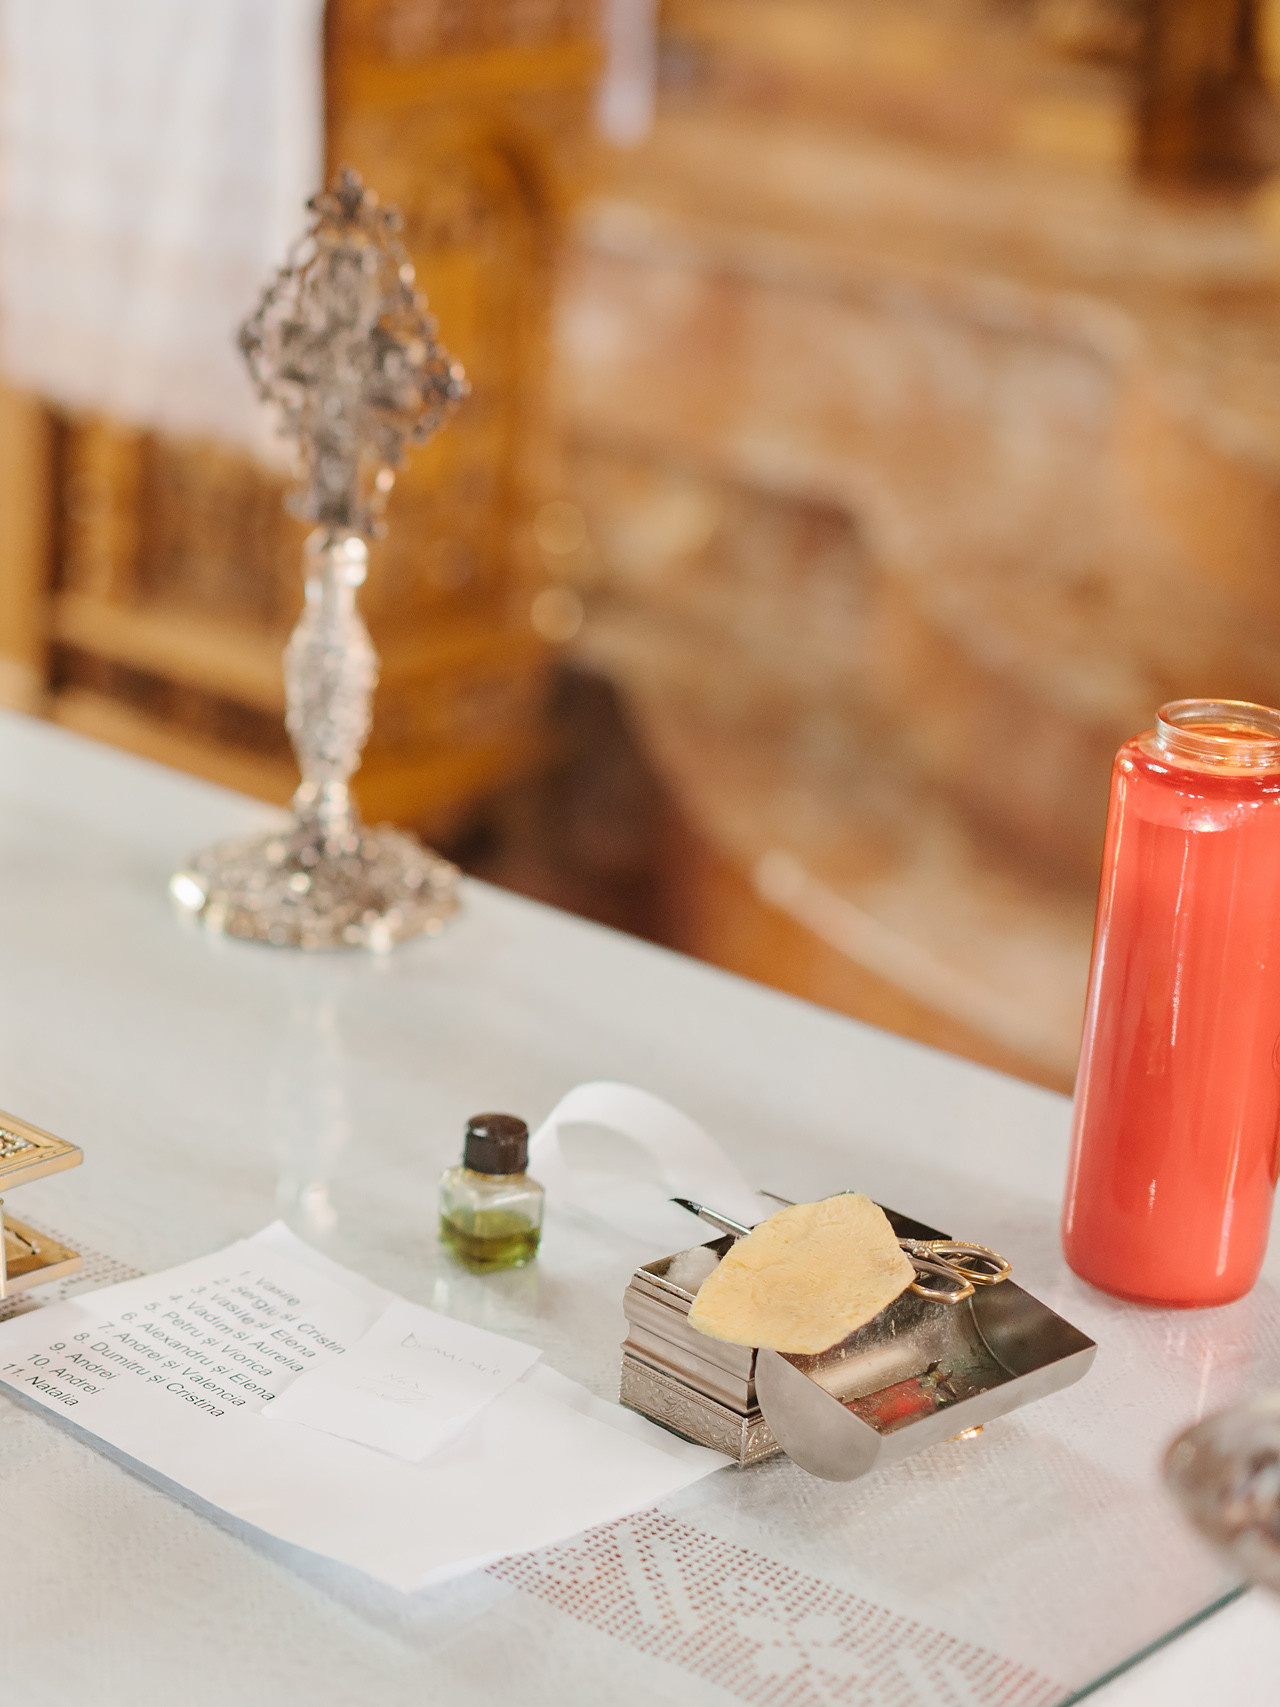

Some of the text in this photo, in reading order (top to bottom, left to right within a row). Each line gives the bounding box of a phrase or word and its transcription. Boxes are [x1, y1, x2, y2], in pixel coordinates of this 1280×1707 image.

[230, 1286, 281, 1316] Sergiu
[256, 1277, 301, 1307] Vasile
[120, 1311, 138, 1325] 6.
[136, 1322, 214, 1366] Alexandru
[228, 1373, 276, 1401] Elena
[144, 1302, 162, 1314] 5.
[161, 1311, 205, 1338] Petru
[221, 1344, 273, 1376] Viorica
[187, 1301, 234, 1335] Vadim
[247, 1341, 304, 1372] Aurelia
[210, 1293, 256, 1325] Vasile
[270, 1328, 317, 1358] Elena
[2, 1362, 80, 1407] 11. Natalia
[27, 1353, 106, 1395] 10. Andrei
[49, 1342, 121, 1380] 9. Andrei
[72, 1332, 91, 1345] 8.
[89, 1341, 151, 1376] Dumitru
[166, 1382, 225, 1417] Cristina
[97, 1321, 116, 1334] 7.
[112, 1333, 169, 1361] Andrei
[181, 1366, 247, 1407] Valencia
